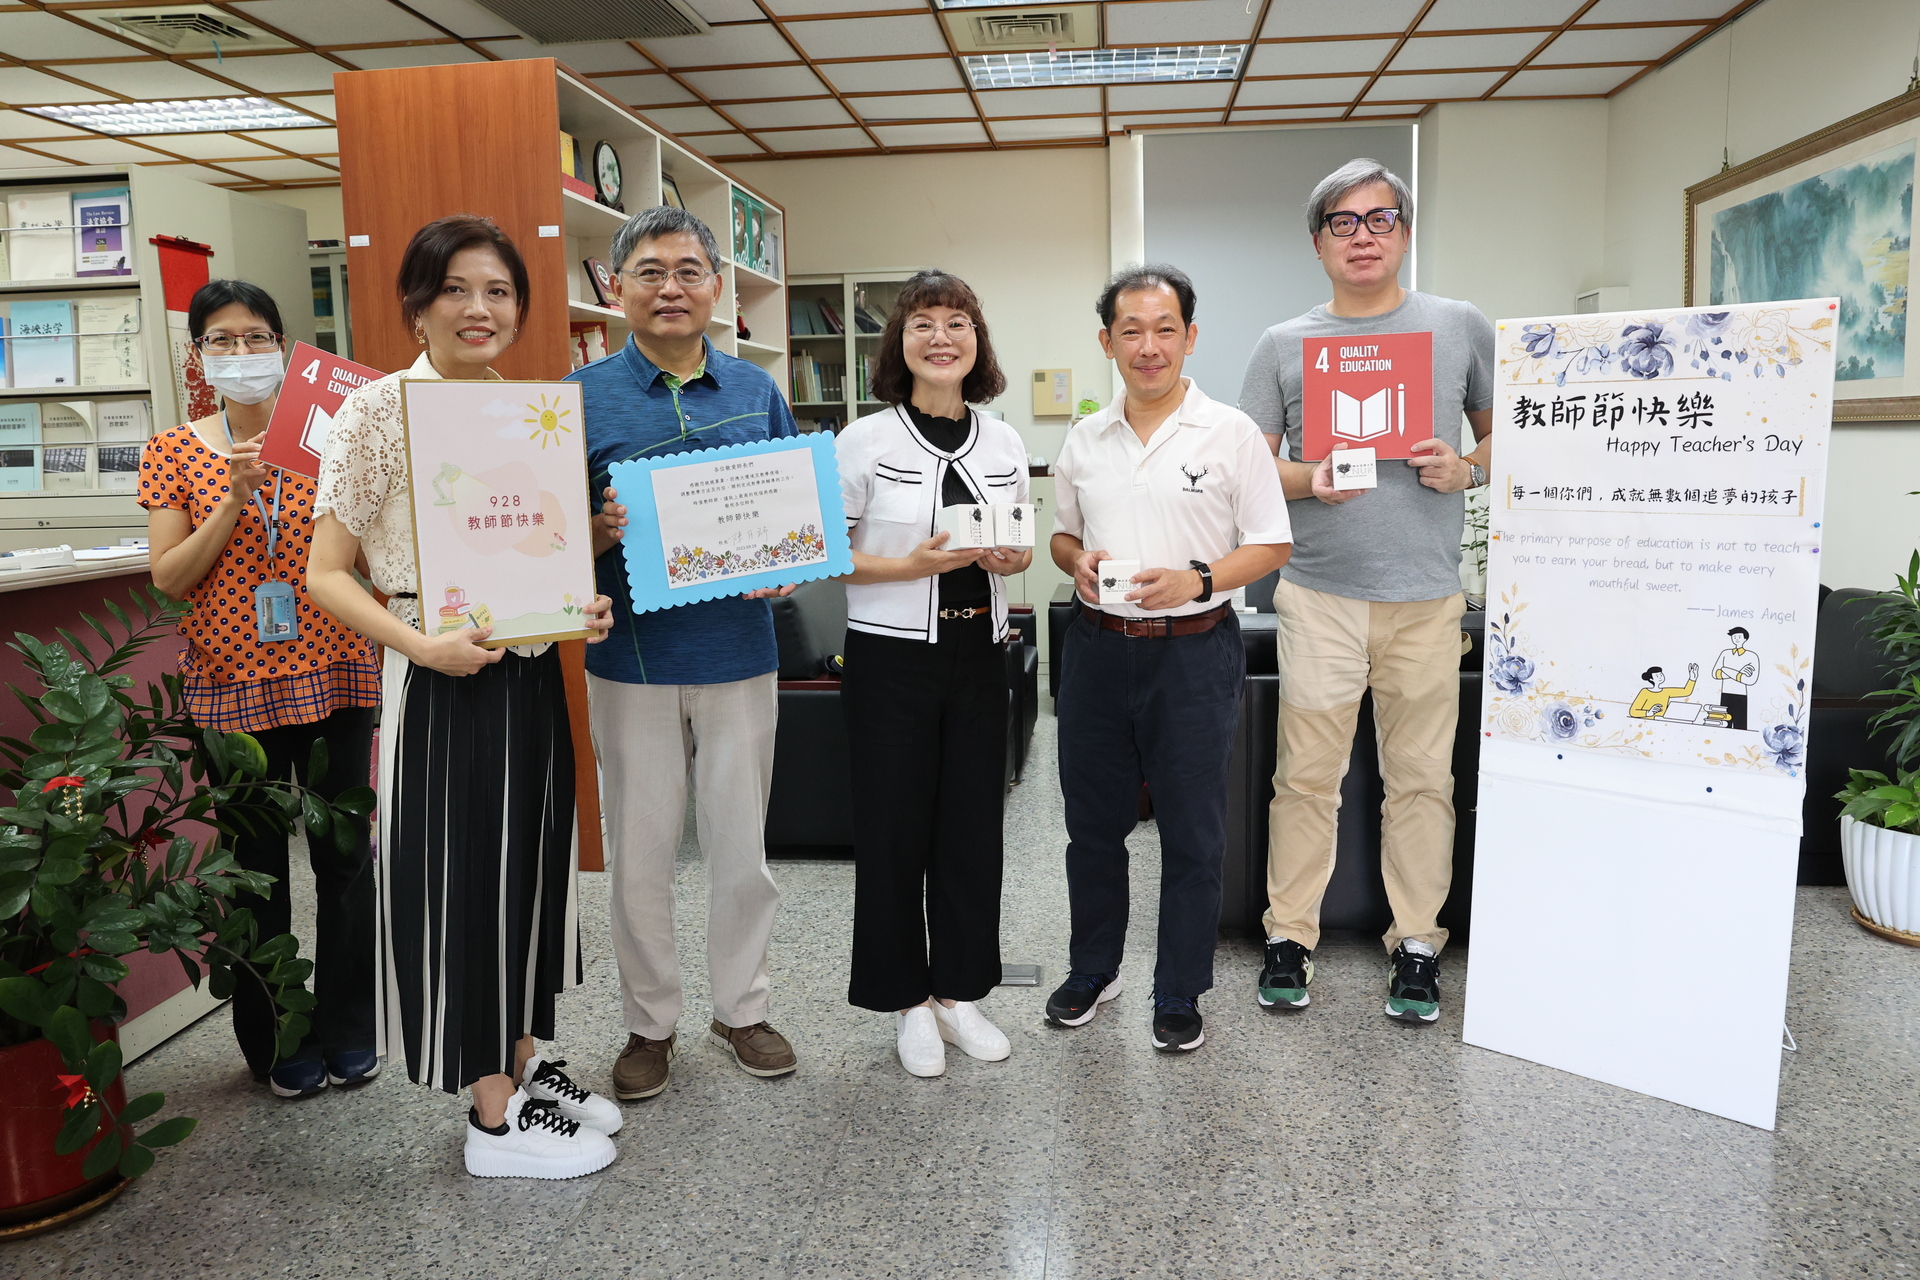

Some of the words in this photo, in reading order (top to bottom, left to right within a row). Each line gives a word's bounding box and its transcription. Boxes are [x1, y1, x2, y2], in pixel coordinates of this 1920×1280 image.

[1315, 347, 1330, 373] 4
[1340, 345, 1379, 359] QUALITY
[301, 359, 321, 384] 4
[1340, 359, 1392, 372] EDUCATION
[1512, 390, 1715, 430] 教師節快樂
[1606, 436, 1660, 456] Happy
[1670, 435, 1755, 452] Teacher's
[1764, 434, 1803, 455] Day
[1352, 467, 1374, 475] NUK
[490, 495, 521, 507] 928
[468, 512, 545, 530] 教師節快樂
[717, 510, 759, 524] 教師節快樂
[1010, 522, 1018, 544] NUK
[1520, 533, 1562, 547] primary
[1568, 536, 1611, 549] purpose
[1617, 535, 1630, 549] of
[1637, 537, 1694, 550] education
[1700, 539, 1710, 550] is
[1717, 541, 1737, 551] not
[1743, 542, 1757, 552] to
[1764, 541, 1800, 553] teach
[1512, 554, 1530, 565] you
[1535, 555, 1546, 564] to
[1551, 557, 1577, 566] earn
[1582, 557, 1608, 569] your
[1655, 558, 1674, 570] but
[1680, 561, 1692, 571] to
[1699, 561, 1732, 573] make
[1738, 565, 1775, 578] every
[1589, 578, 1639, 592] mouthful
[1645, 581, 1682, 592] sweet.
[1761, 607, 1796, 624] Angel
